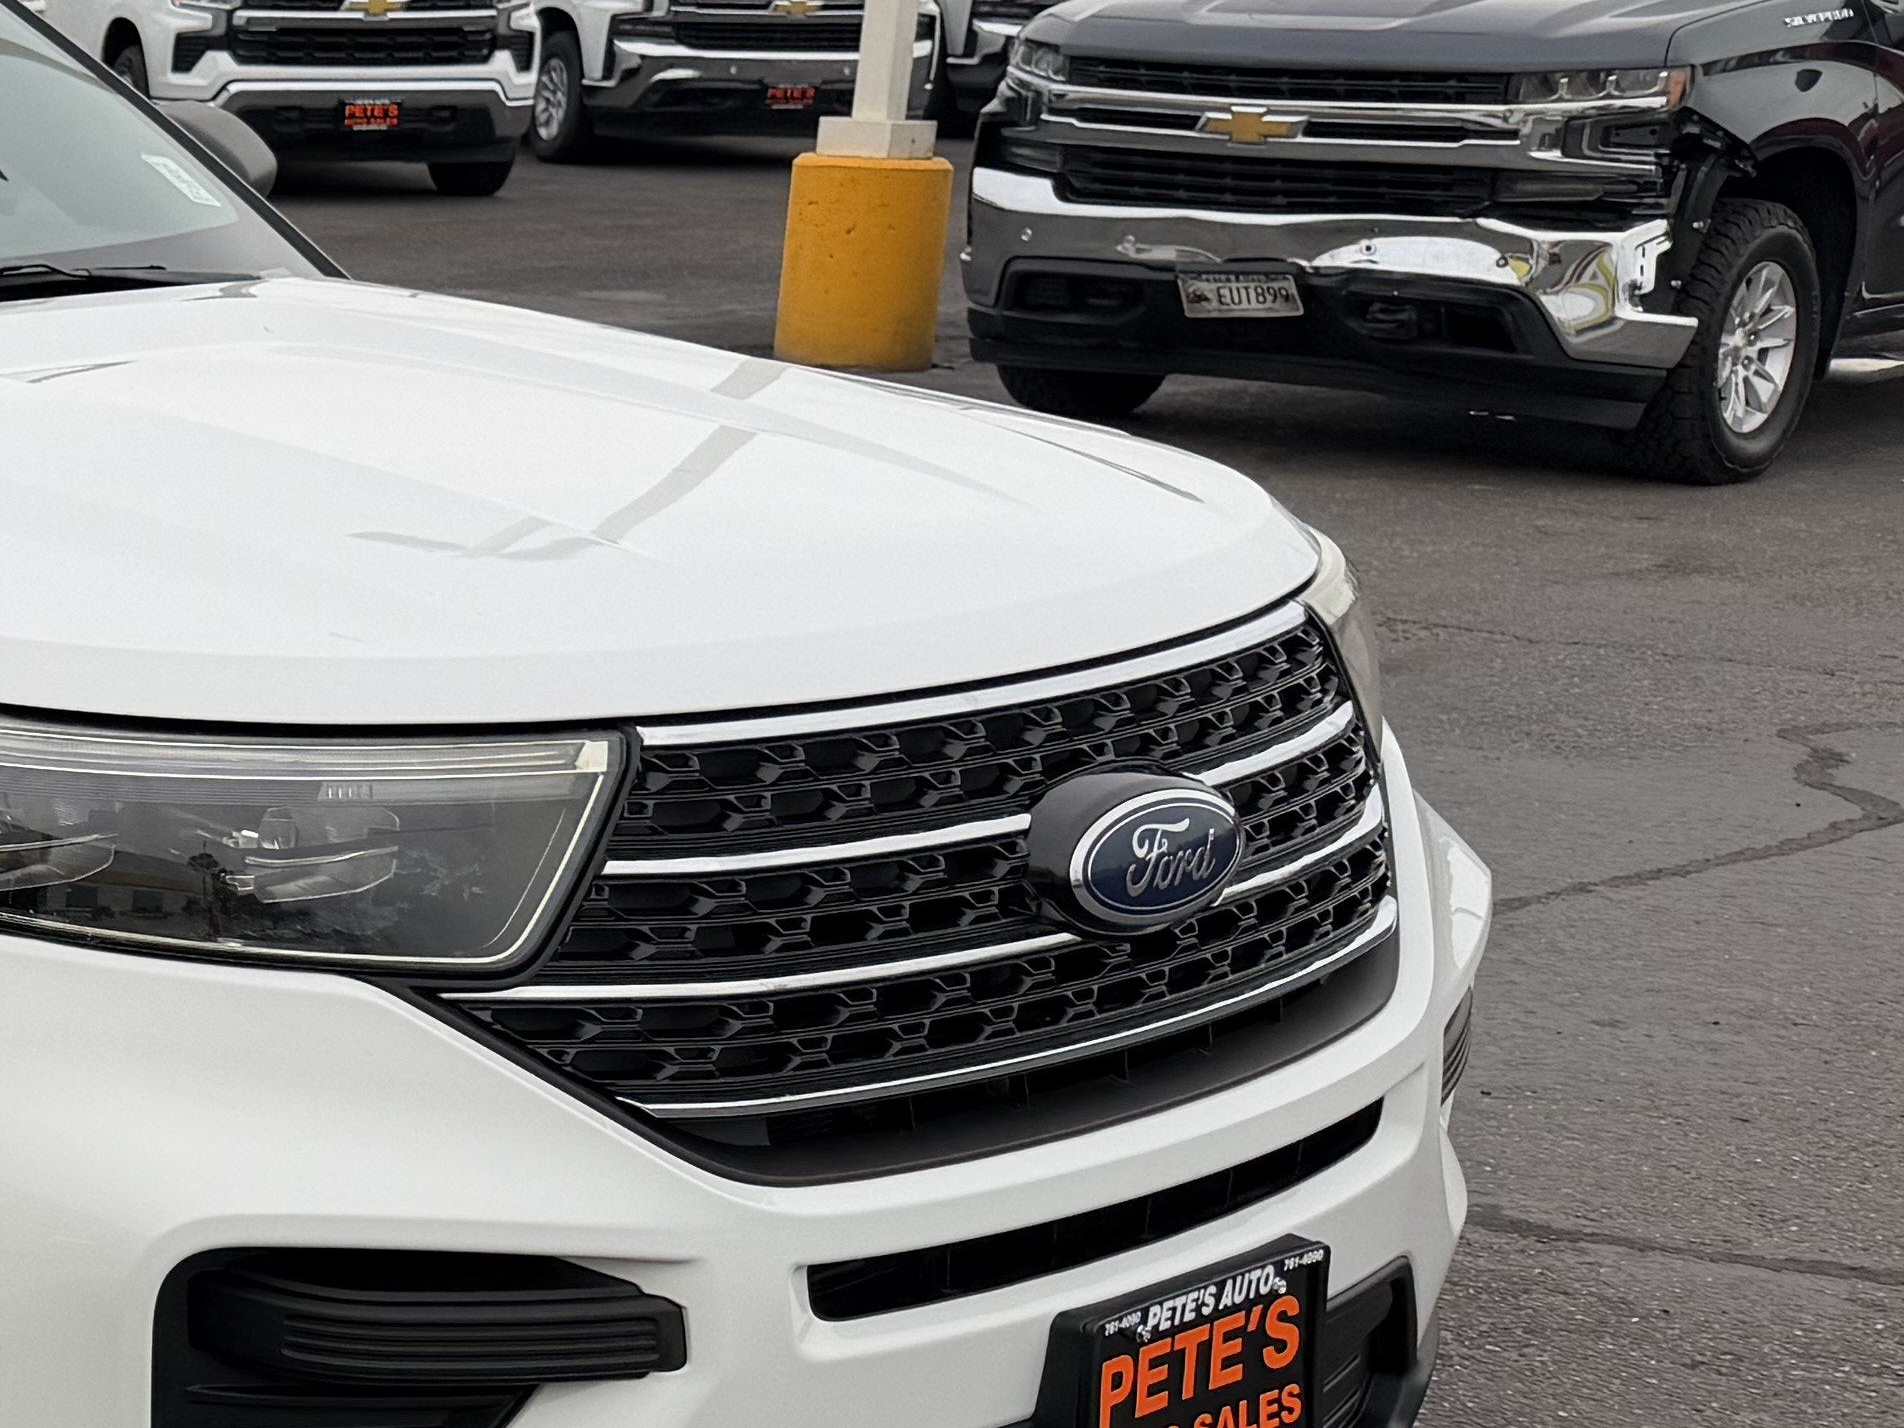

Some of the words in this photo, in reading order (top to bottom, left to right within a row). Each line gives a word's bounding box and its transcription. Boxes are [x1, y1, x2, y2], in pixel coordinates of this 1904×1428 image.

[1217, 285, 1290, 306] EUT899
[1126, 818, 1217, 897] Ford
[1147, 1293, 1216, 1334] PETE'S
[1218, 1264, 1274, 1310] AUTO
